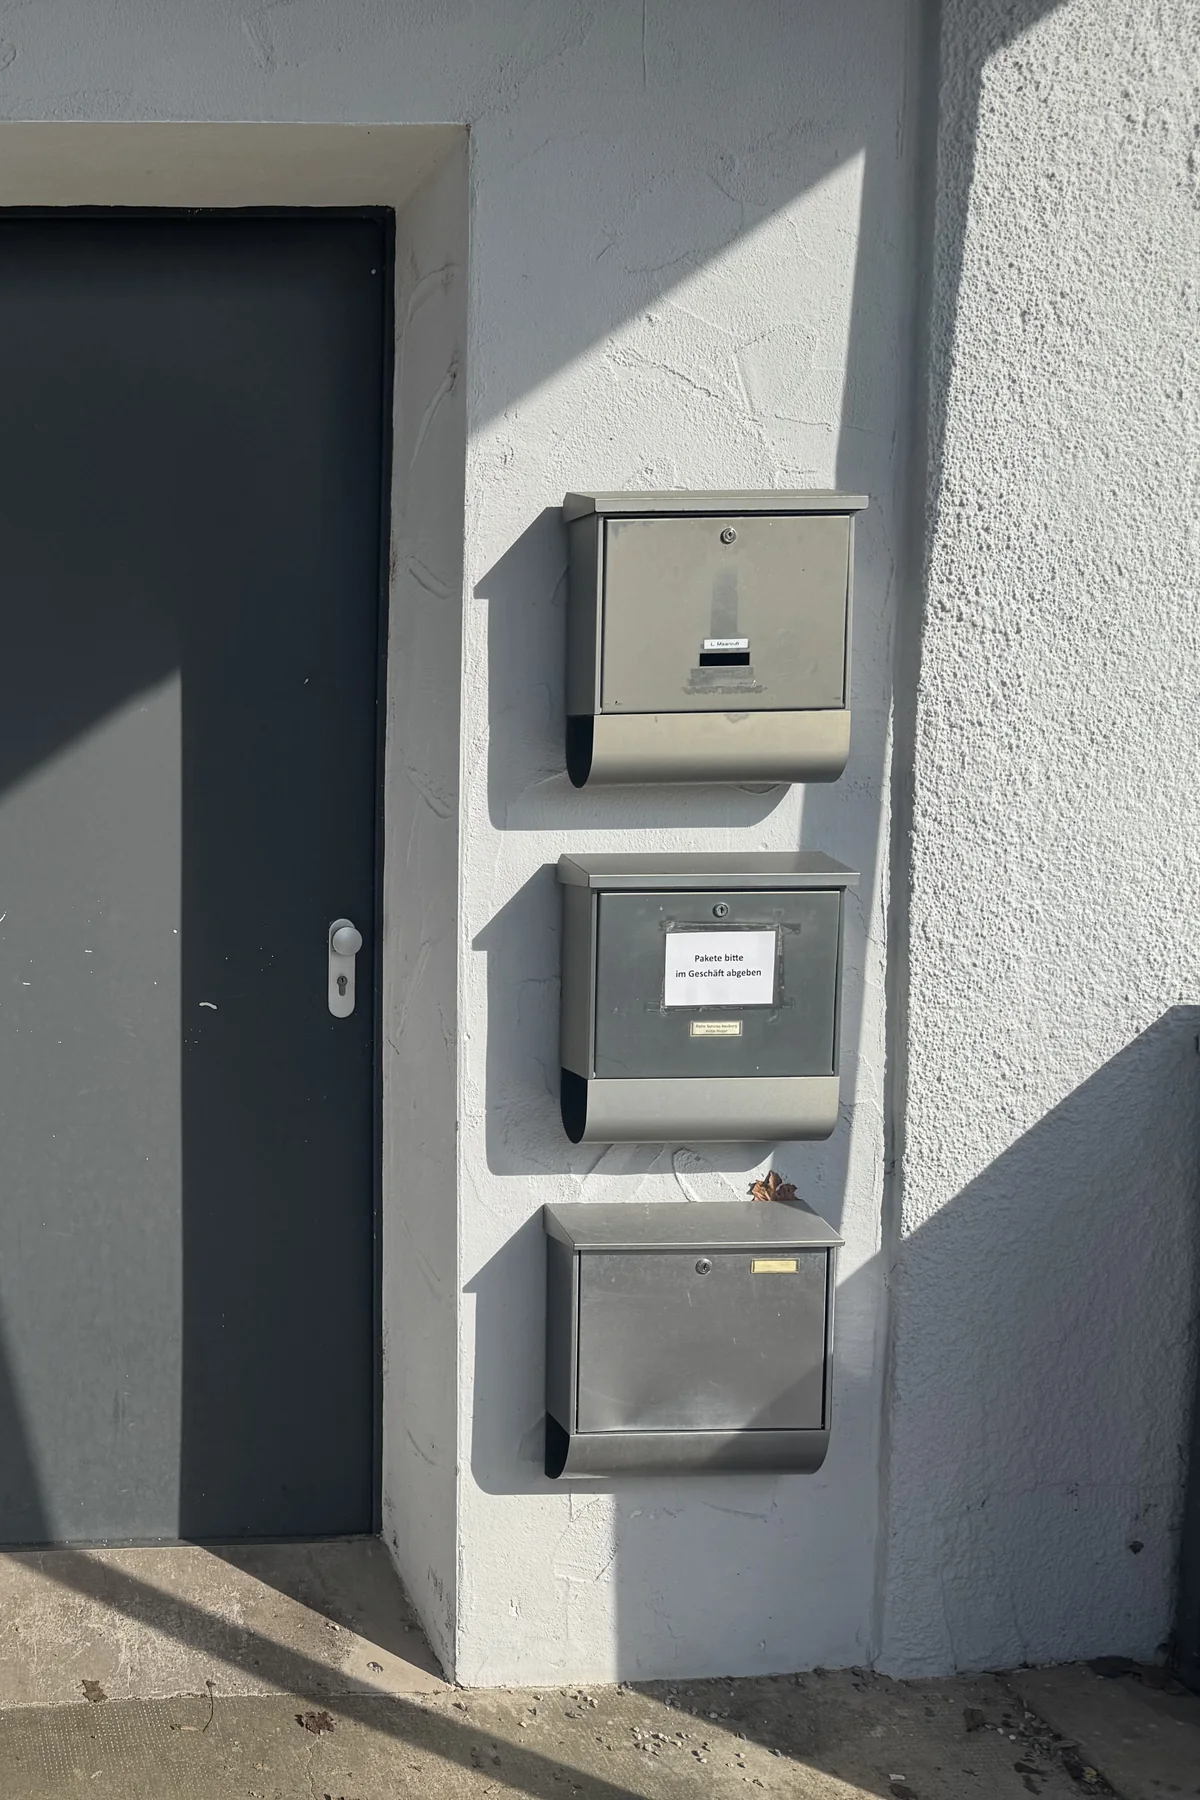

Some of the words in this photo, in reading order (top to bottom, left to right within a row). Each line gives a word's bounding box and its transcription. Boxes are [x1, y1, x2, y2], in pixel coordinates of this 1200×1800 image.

[724, 954, 744, 962] bitte
[675, 969, 686, 978] im
[688, 968, 725, 978] Geschäft
[726, 969, 762, 978] abgeben
